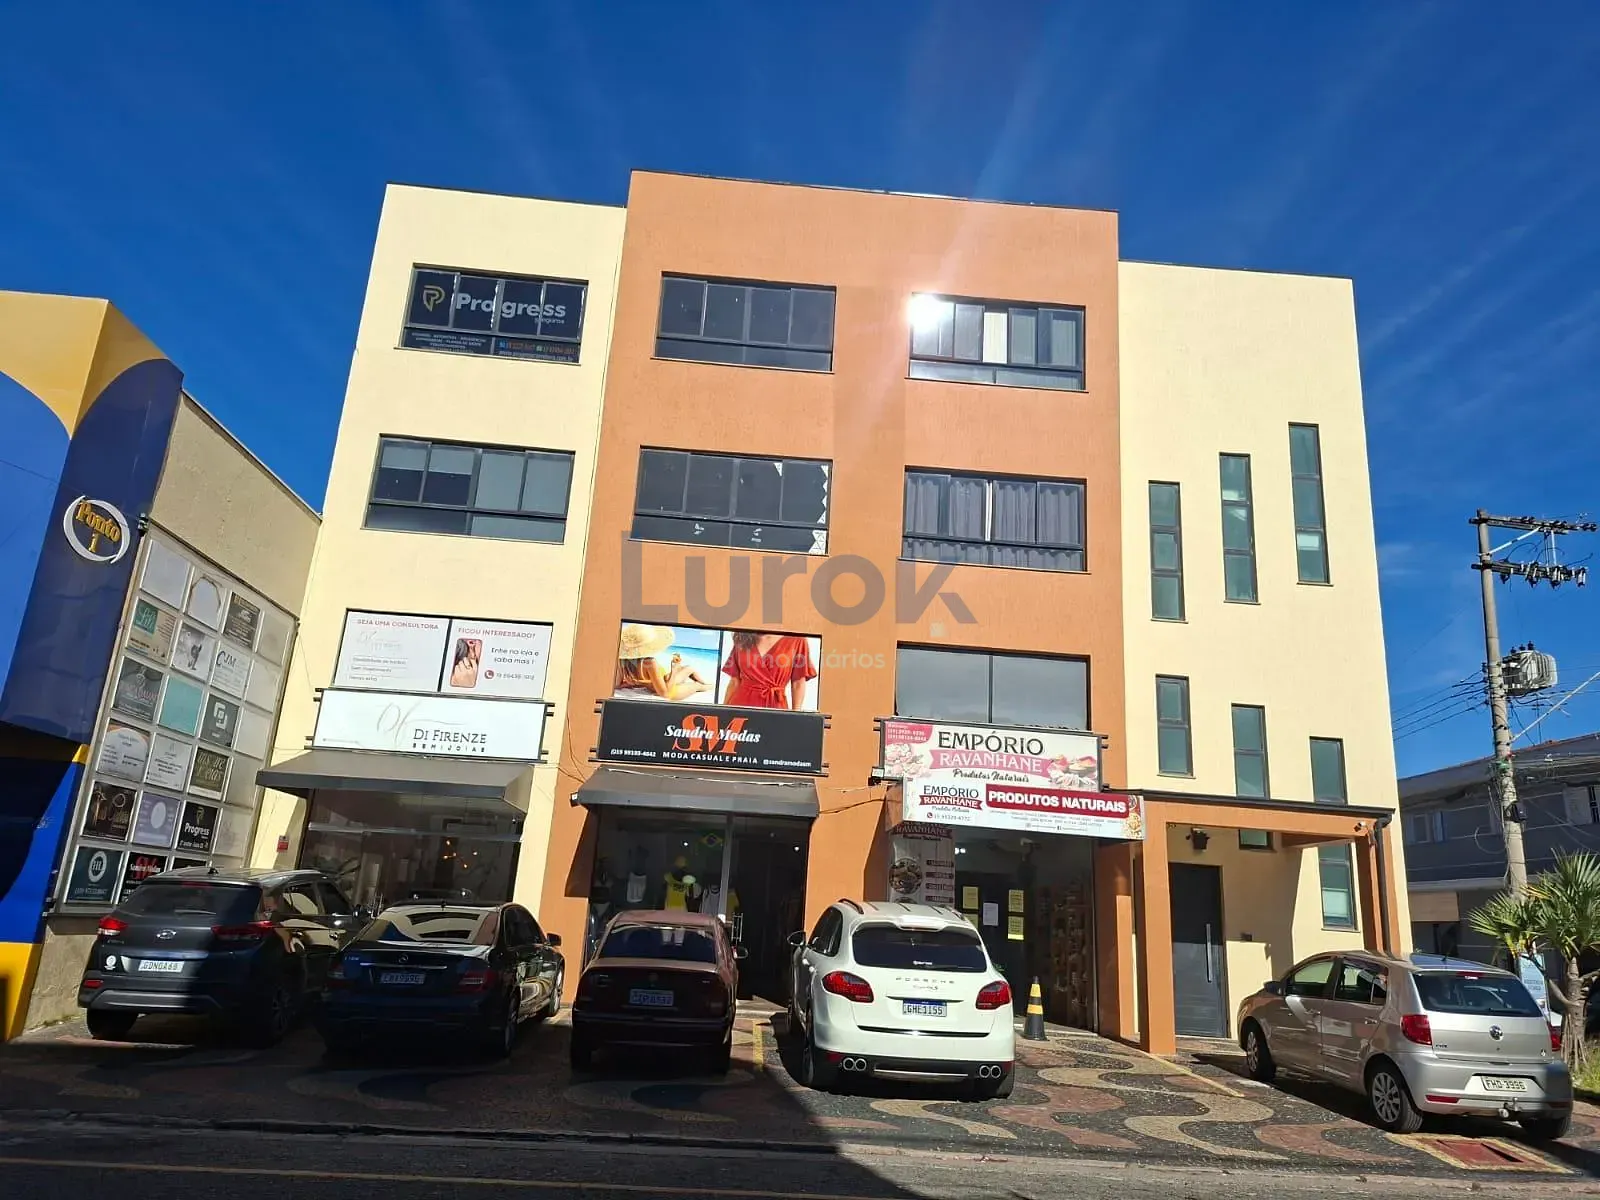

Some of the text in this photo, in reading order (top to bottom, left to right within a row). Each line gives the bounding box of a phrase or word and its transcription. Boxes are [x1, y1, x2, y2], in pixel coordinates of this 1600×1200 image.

[455, 293, 566, 318] Progress
[76, 502, 120, 542] Ponto
[664, 725, 761, 743] Sandra Modas
[938, 731, 1044, 756] EMPÓRIO
[662, 751, 689, 760] MODA
[690, 754, 723, 762] CASUAL
[732, 756, 758, 764] PRAIA
[939, 753, 1043, 773] RAVANHANE
[952, 769, 1029, 783] Produtos Naturais
[923, 784, 979, 799] EMPÓRIO
[923, 796, 978, 808] RAVANHANE
[988, 791, 1127, 813] PRODUTOS NATURAIS
